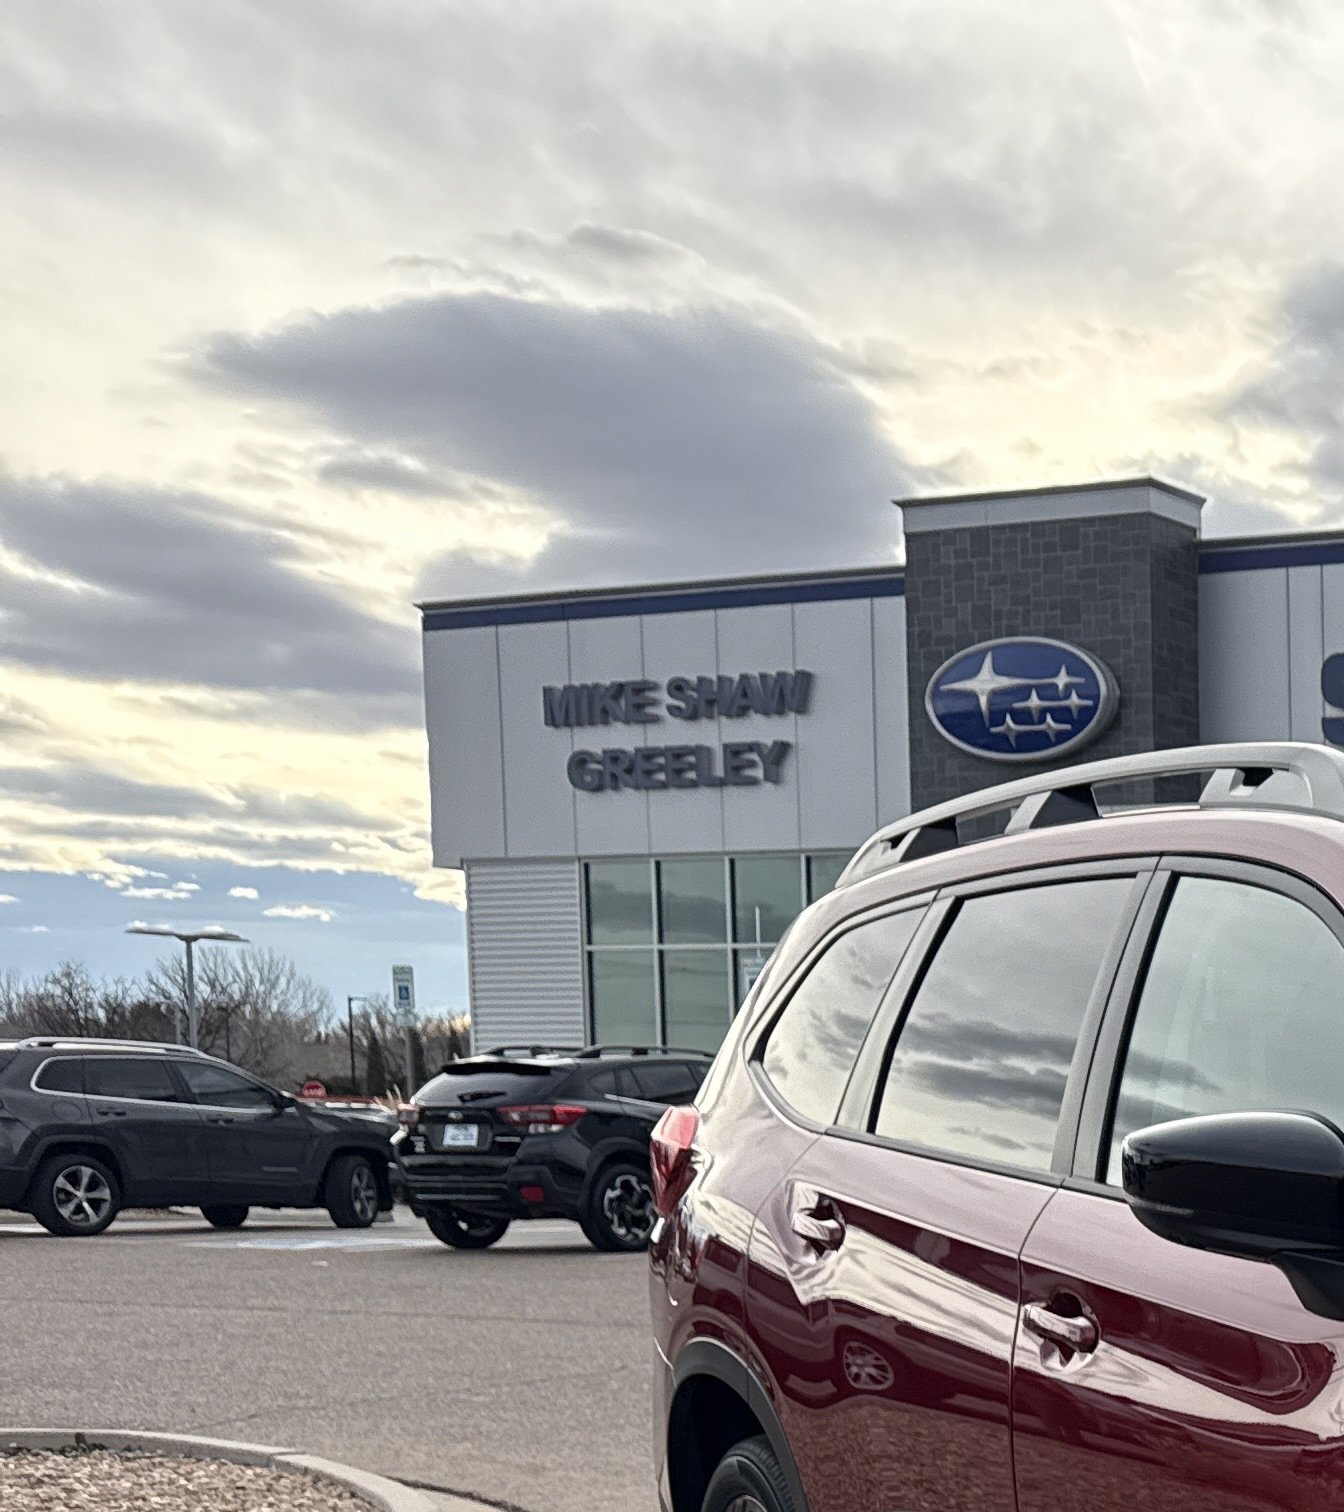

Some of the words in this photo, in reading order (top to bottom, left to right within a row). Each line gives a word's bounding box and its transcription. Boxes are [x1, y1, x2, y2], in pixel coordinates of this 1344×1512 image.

[542, 680, 662, 728] MIKE
[665, 669, 815, 721] SHAW
[567, 739, 794, 792] GREELEY
